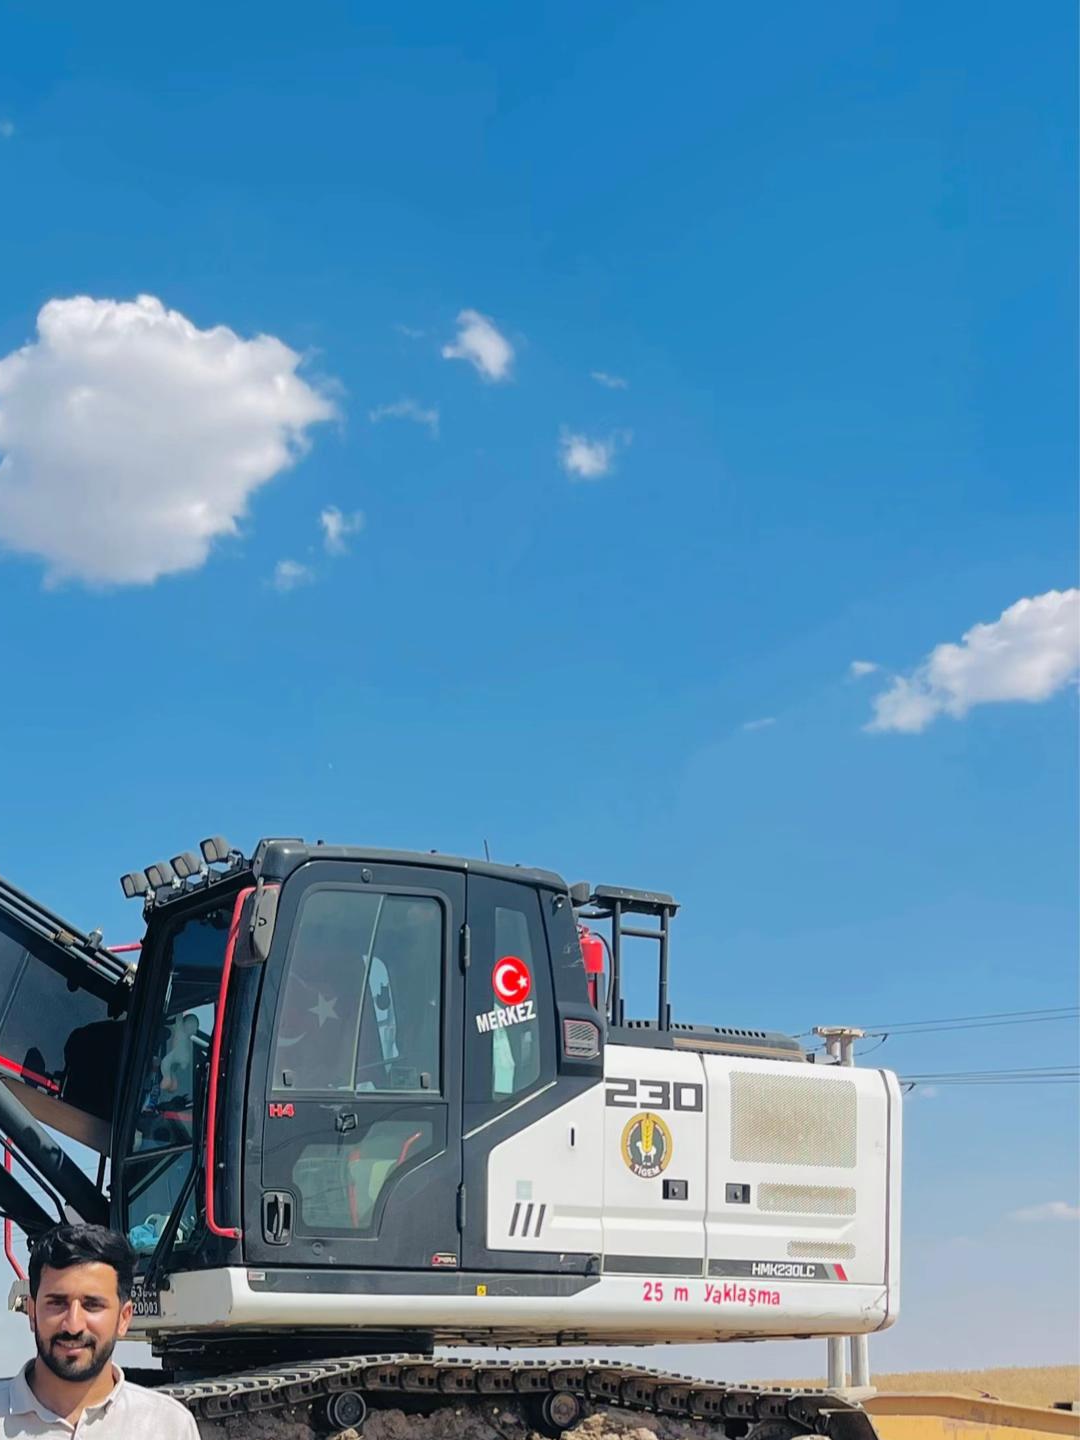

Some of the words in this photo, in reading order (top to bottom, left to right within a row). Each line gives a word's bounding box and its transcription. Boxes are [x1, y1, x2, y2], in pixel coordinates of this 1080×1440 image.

[475, 1000, 536, 1033] MERKEZ
[605, 1077, 703, 1112] 230
[268, 1103, 295, 1118] H4
[751, 1262, 816, 1278] HMK230LC
[643, 1281, 664, 1302] 25
[674, 1285, 689, 1301] m
